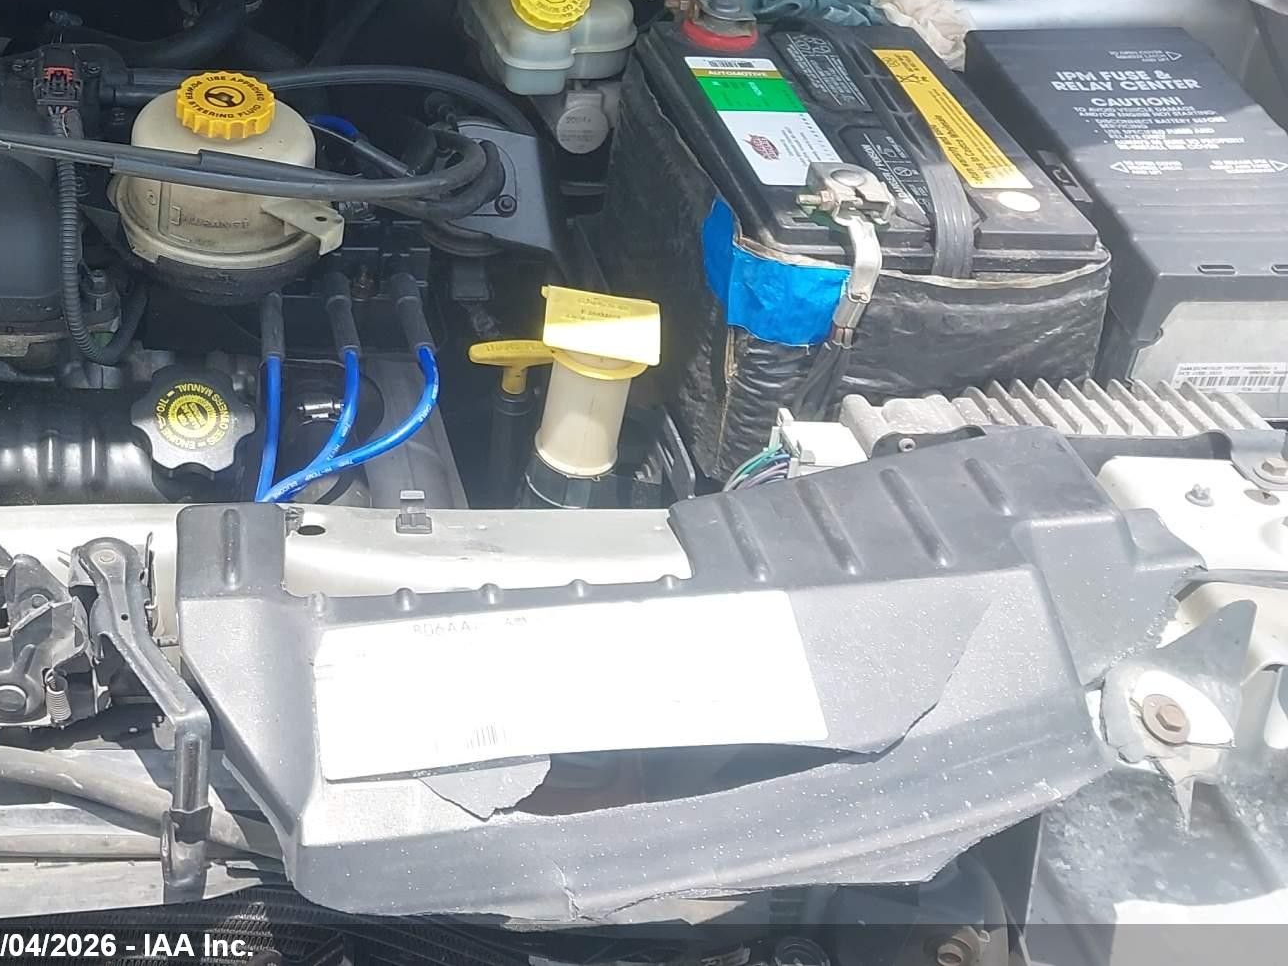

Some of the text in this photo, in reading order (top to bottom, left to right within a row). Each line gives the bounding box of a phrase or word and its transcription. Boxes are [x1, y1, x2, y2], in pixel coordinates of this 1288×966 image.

[1056, 68, 1172, 82] IPM FUSE &
[229, 76, 264, 101] APPROVED
[1050, 78, 1203, 92] RELAY CENTER
[185, 80, 261, 119] POWER STEERING FLUID
[1090, 96, 1185, 107] CAUTION!
[174, 383, 214, 397] MANUAL
[155, 398, 170, 413] OIL
[160, 426, 196, 450] ENGINE
